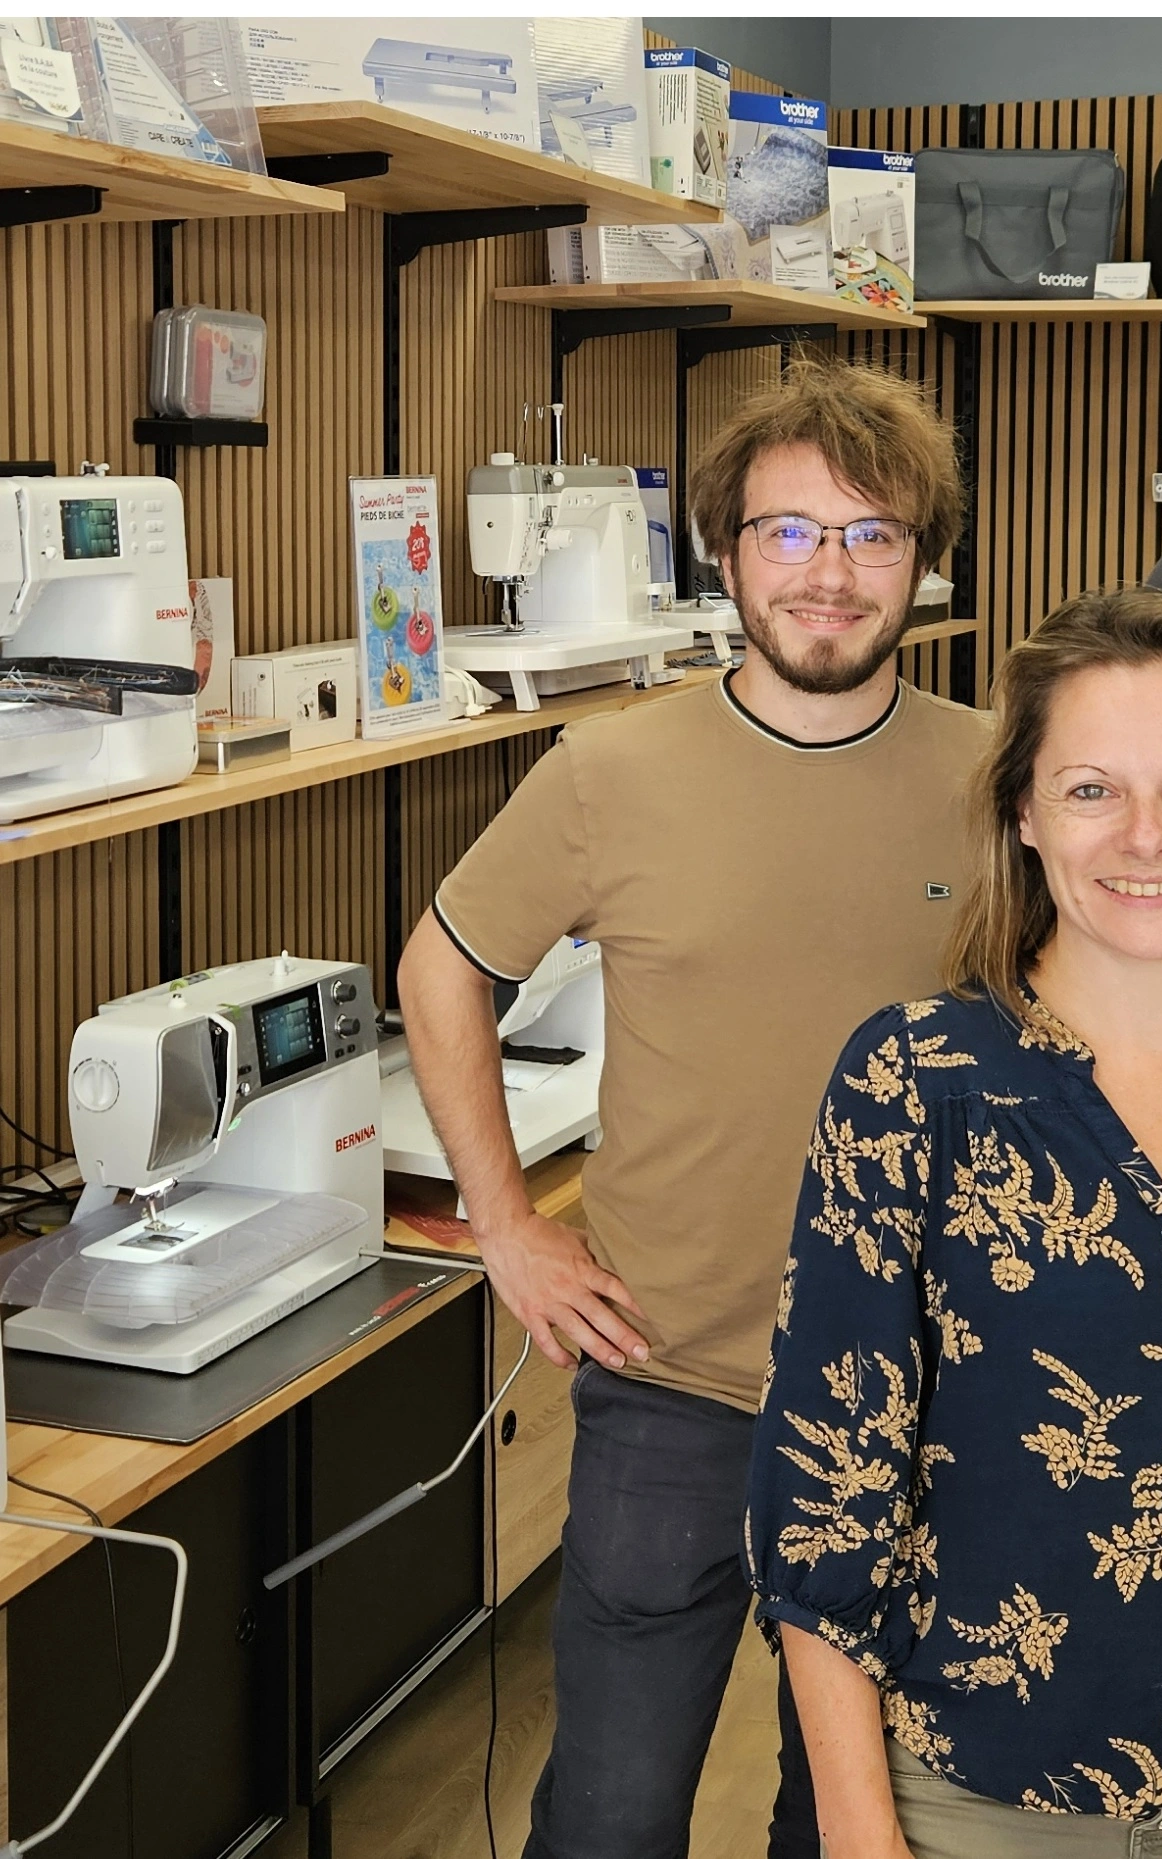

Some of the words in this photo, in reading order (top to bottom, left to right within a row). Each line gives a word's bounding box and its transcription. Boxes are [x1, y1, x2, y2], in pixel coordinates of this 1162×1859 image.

[650, 52, 684, 62] brother
[780, 100, 819, 119] brother
[883, 154, 914, 166] brother
[1039, 272, 1088, 287] brother
[359, 495, 385, 509] Summer
[386, 493, 404, 508] Party
[360, 511, 377, 521] PIEDS
[379, 510, 387, 520] DE
[156, 608, 188, 620] BERNINA
[205, 708, 228, 716] BERNINA
[335, 1124, 376, 1153] BERNINA
